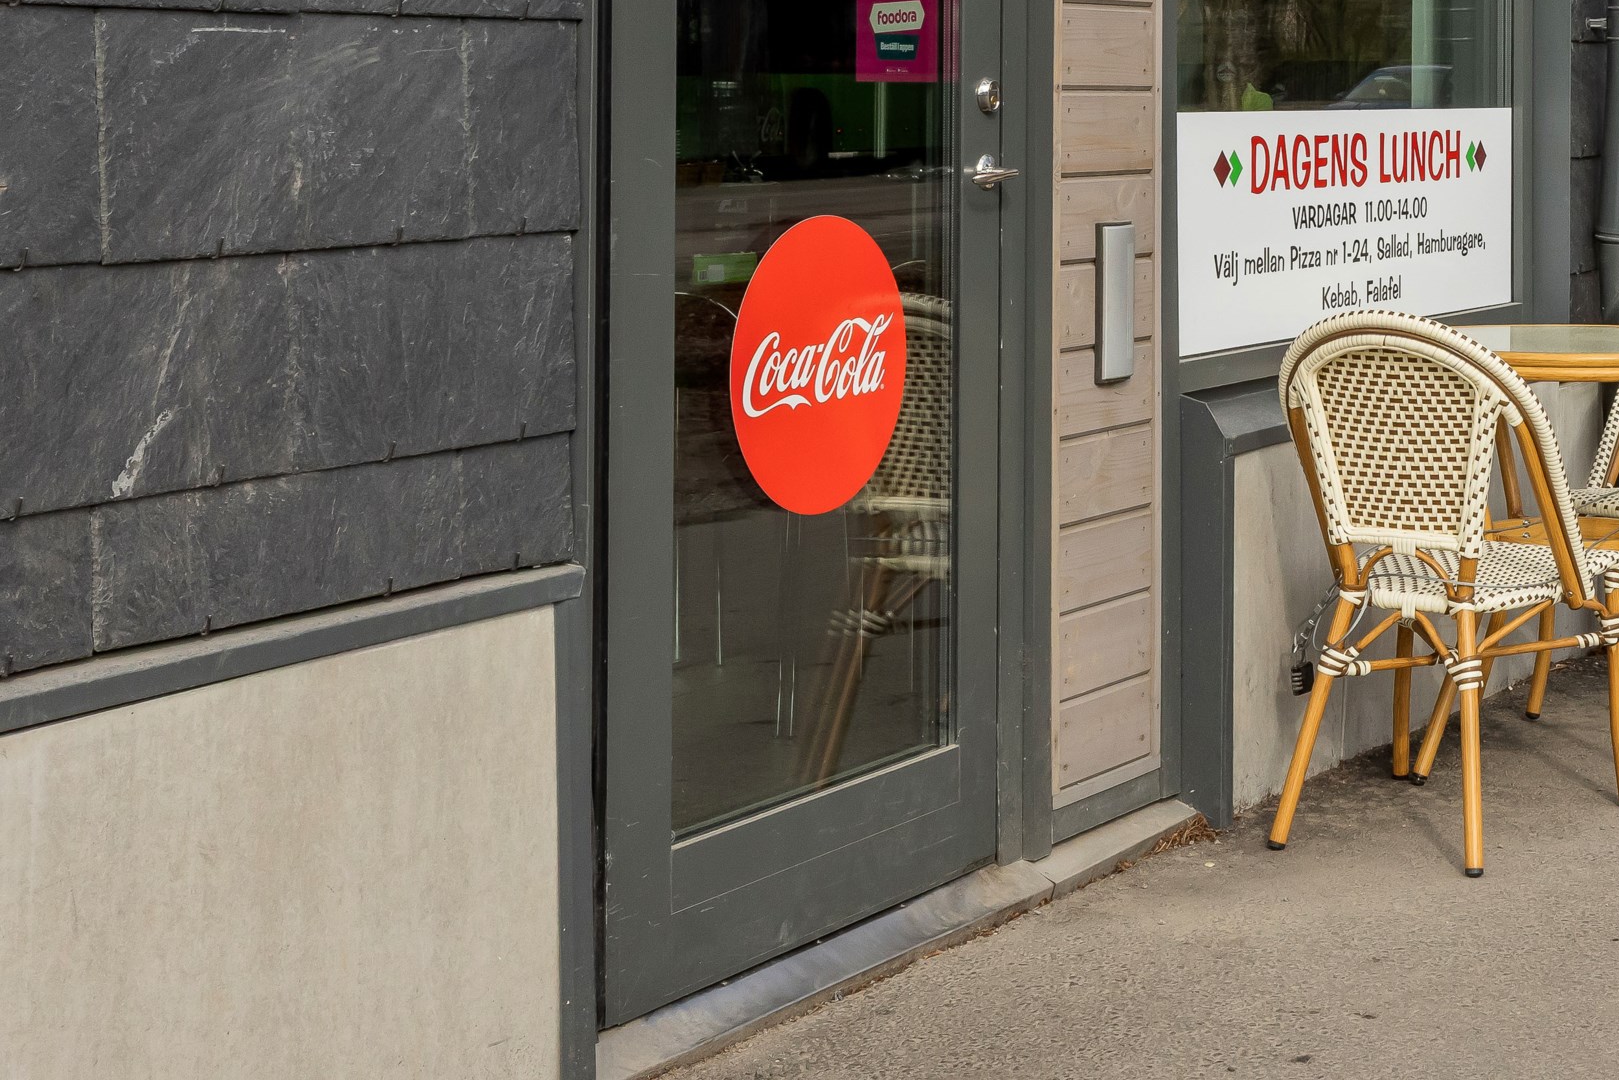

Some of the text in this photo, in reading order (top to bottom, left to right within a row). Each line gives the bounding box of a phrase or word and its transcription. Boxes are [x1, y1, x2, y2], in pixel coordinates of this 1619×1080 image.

[877, 9, 917, 25] foodora
[1250, 129, 1462, 195] DAGENS LUNCH
[1292, 196, 1428, 230] VARDAGAR 11.00-14.00
[1213, 229, 1486, 286] Välj mellan Pizza nr 1-24, Sallad, Hamburagare,
[1322, 275, 1402, 311] Kebab, Falafel
[742, 311, 894, 418] Coca-Cola
